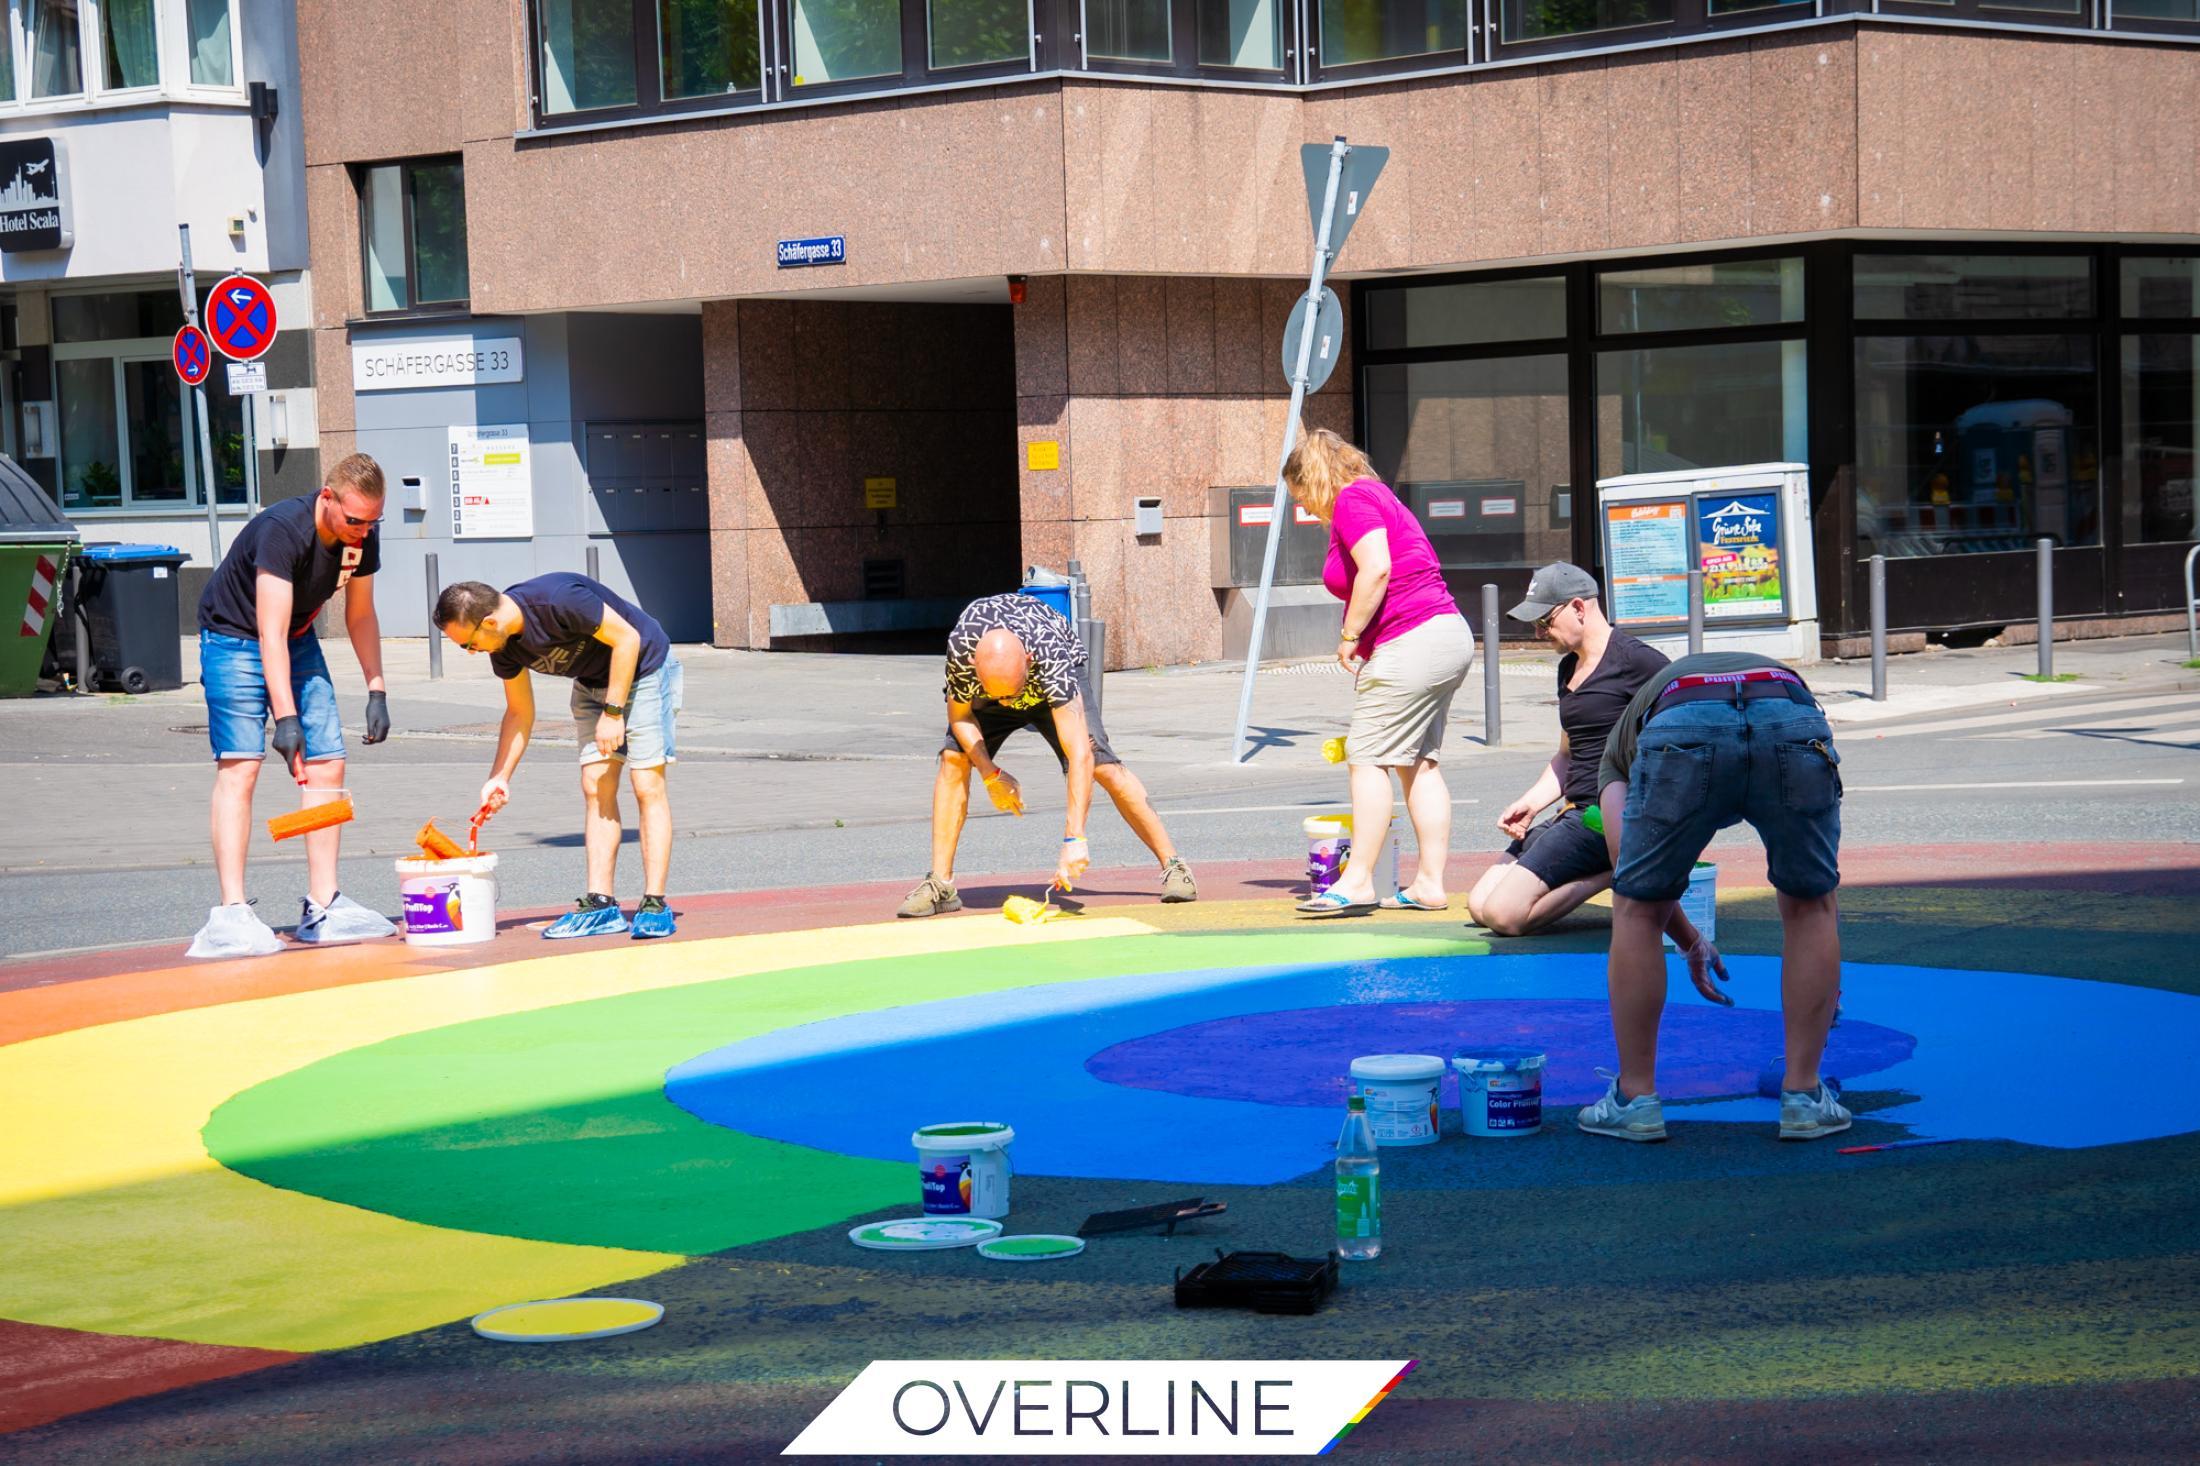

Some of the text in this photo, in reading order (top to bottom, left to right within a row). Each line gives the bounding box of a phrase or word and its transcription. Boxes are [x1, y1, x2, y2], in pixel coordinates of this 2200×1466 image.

[0, 210, 59, 233] Hotel Scala
[779, 239, 841, 263] Schäfergasse 33
[364, 350, 510, 377] SCHÄFERGASSE 33
[467, 428, 501, 440] Sfergasse
[1704, 674, 1746, 683] PUMA
[1488, 1099, 1512, 1109] Color
